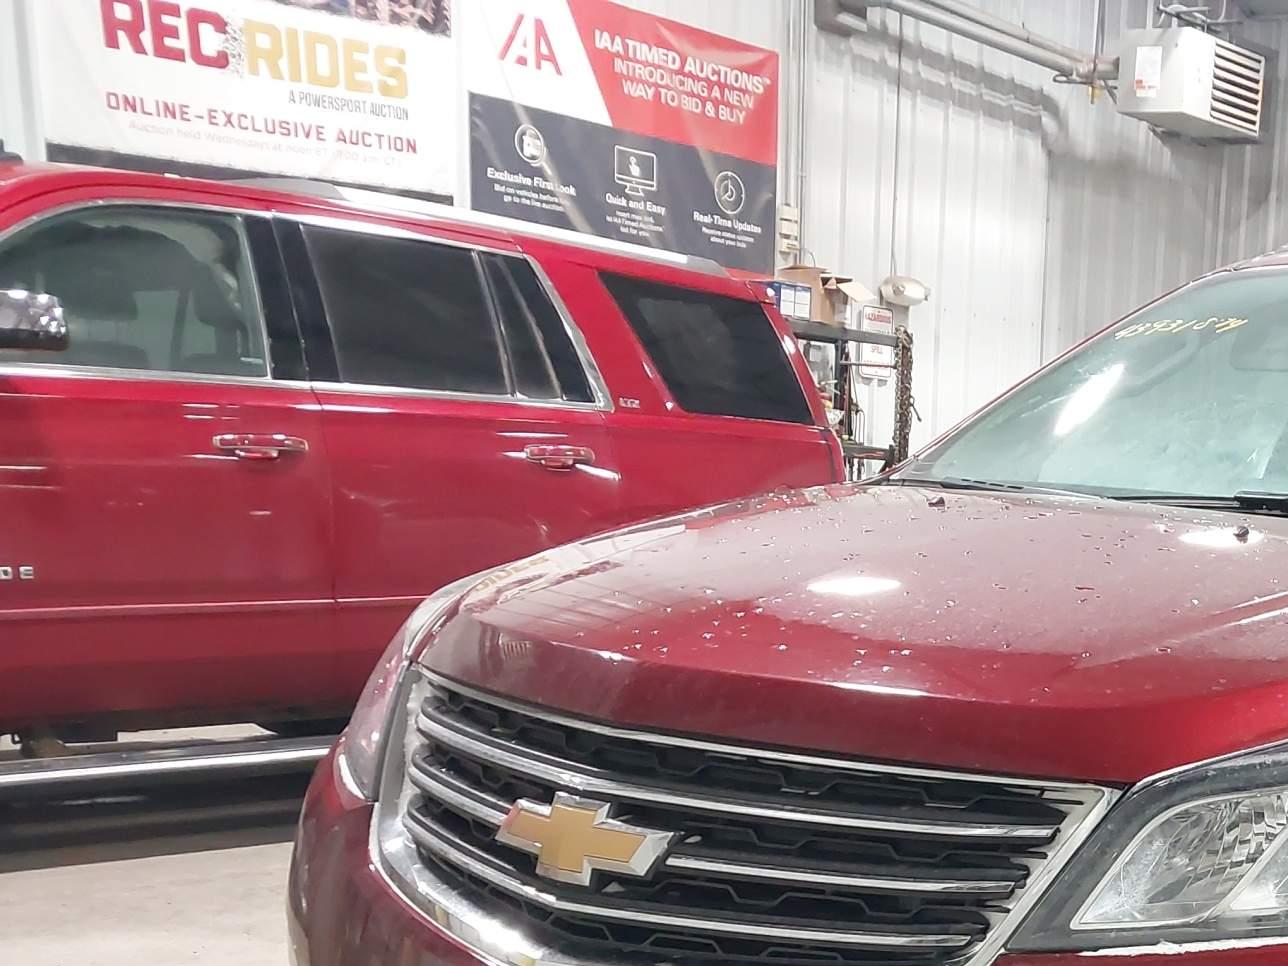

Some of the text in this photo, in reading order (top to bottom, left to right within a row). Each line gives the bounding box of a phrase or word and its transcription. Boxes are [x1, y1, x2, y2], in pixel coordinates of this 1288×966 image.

[99, 0, 409, 98] REC RIDES
[594, 29, 625, 56] IAA
[625, 38, 681, 70] TIMED
[614, 57, 755, 109] INTRODUCING A NEW
[622, 78, 747, 125] WAY TO BID & BUY
[105, 91, 418, 154] ONLINE-EXCLUSIVE AUCTION
[288, 90, 409, 121] A POWERSPORT AUCTION
[486, 166, 533, 187] Exclusive
[605, 192, 667, 216] Quick and Easy
[693, 211, 762, 235] Real-Time Updates
